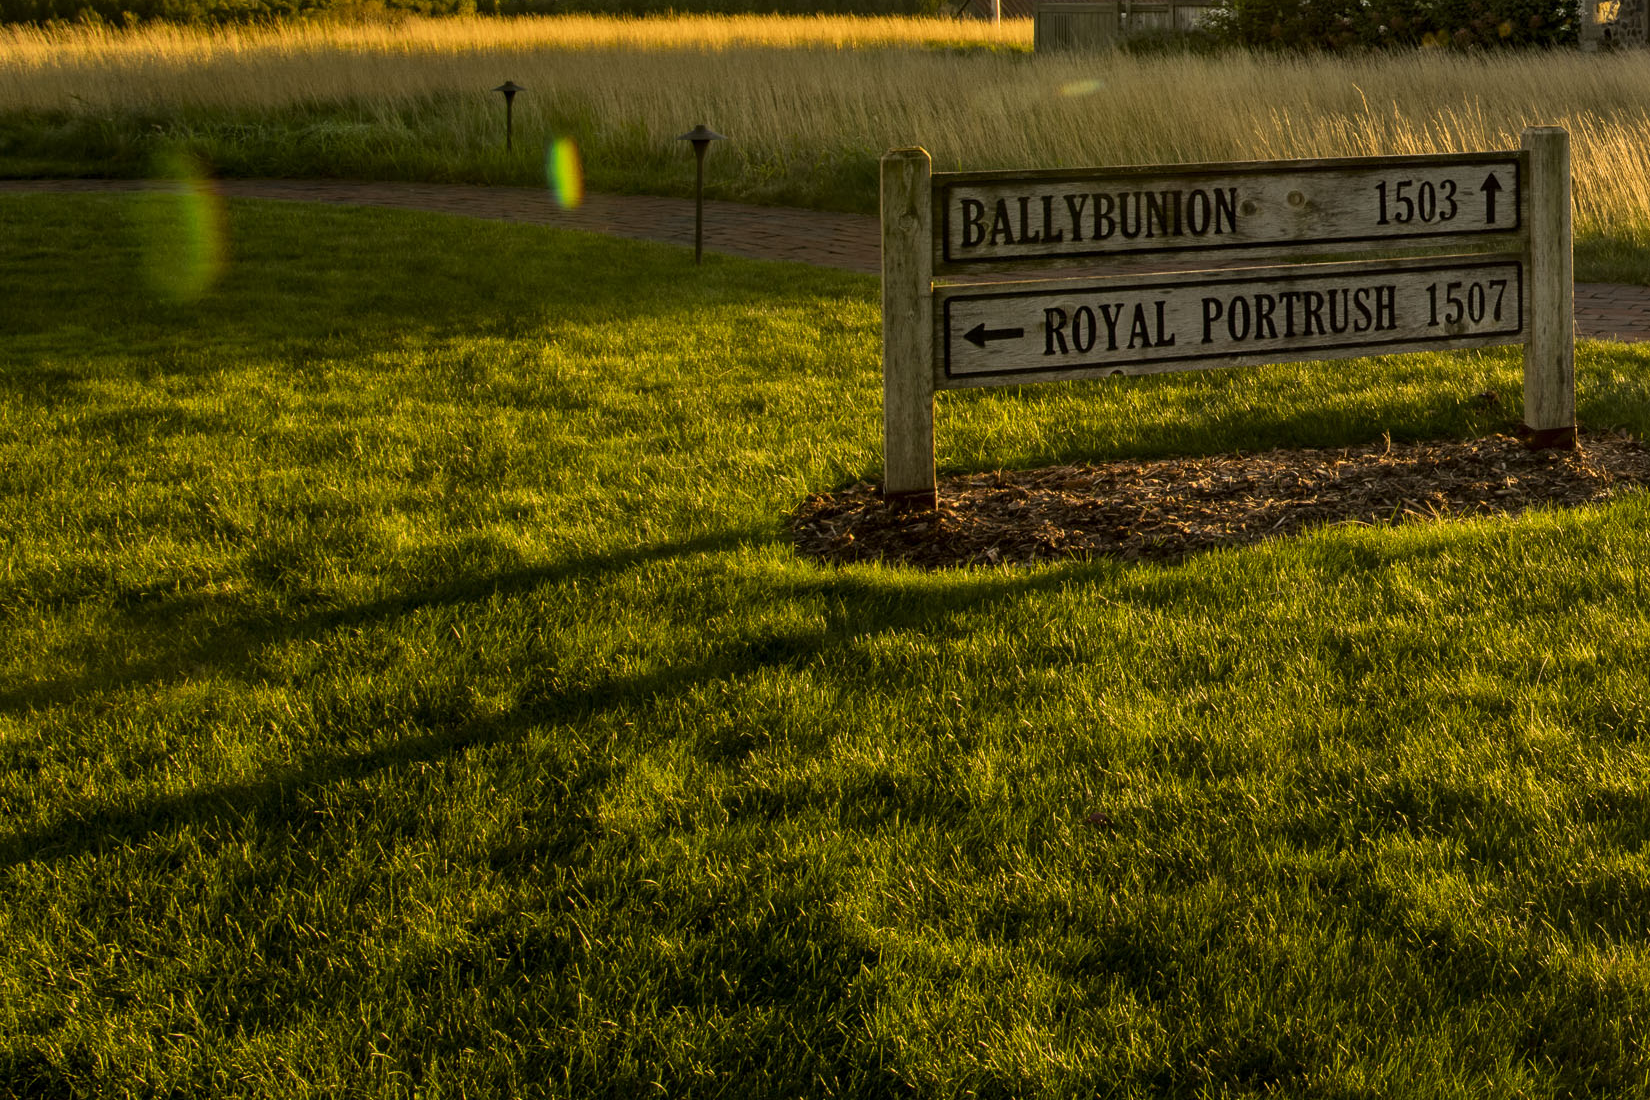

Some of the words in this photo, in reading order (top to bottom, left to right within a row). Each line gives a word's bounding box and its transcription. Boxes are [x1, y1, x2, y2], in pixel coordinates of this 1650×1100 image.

[960, 187, 1238, 248] BALLYBUNION
[1375, 179, 1458, 226] 1503
[1043, 300, 1176, 356] ROYAL
[1200, 285, 1398, 345] PORTRUSH
[1425, 279, 1508, 327] 1507
